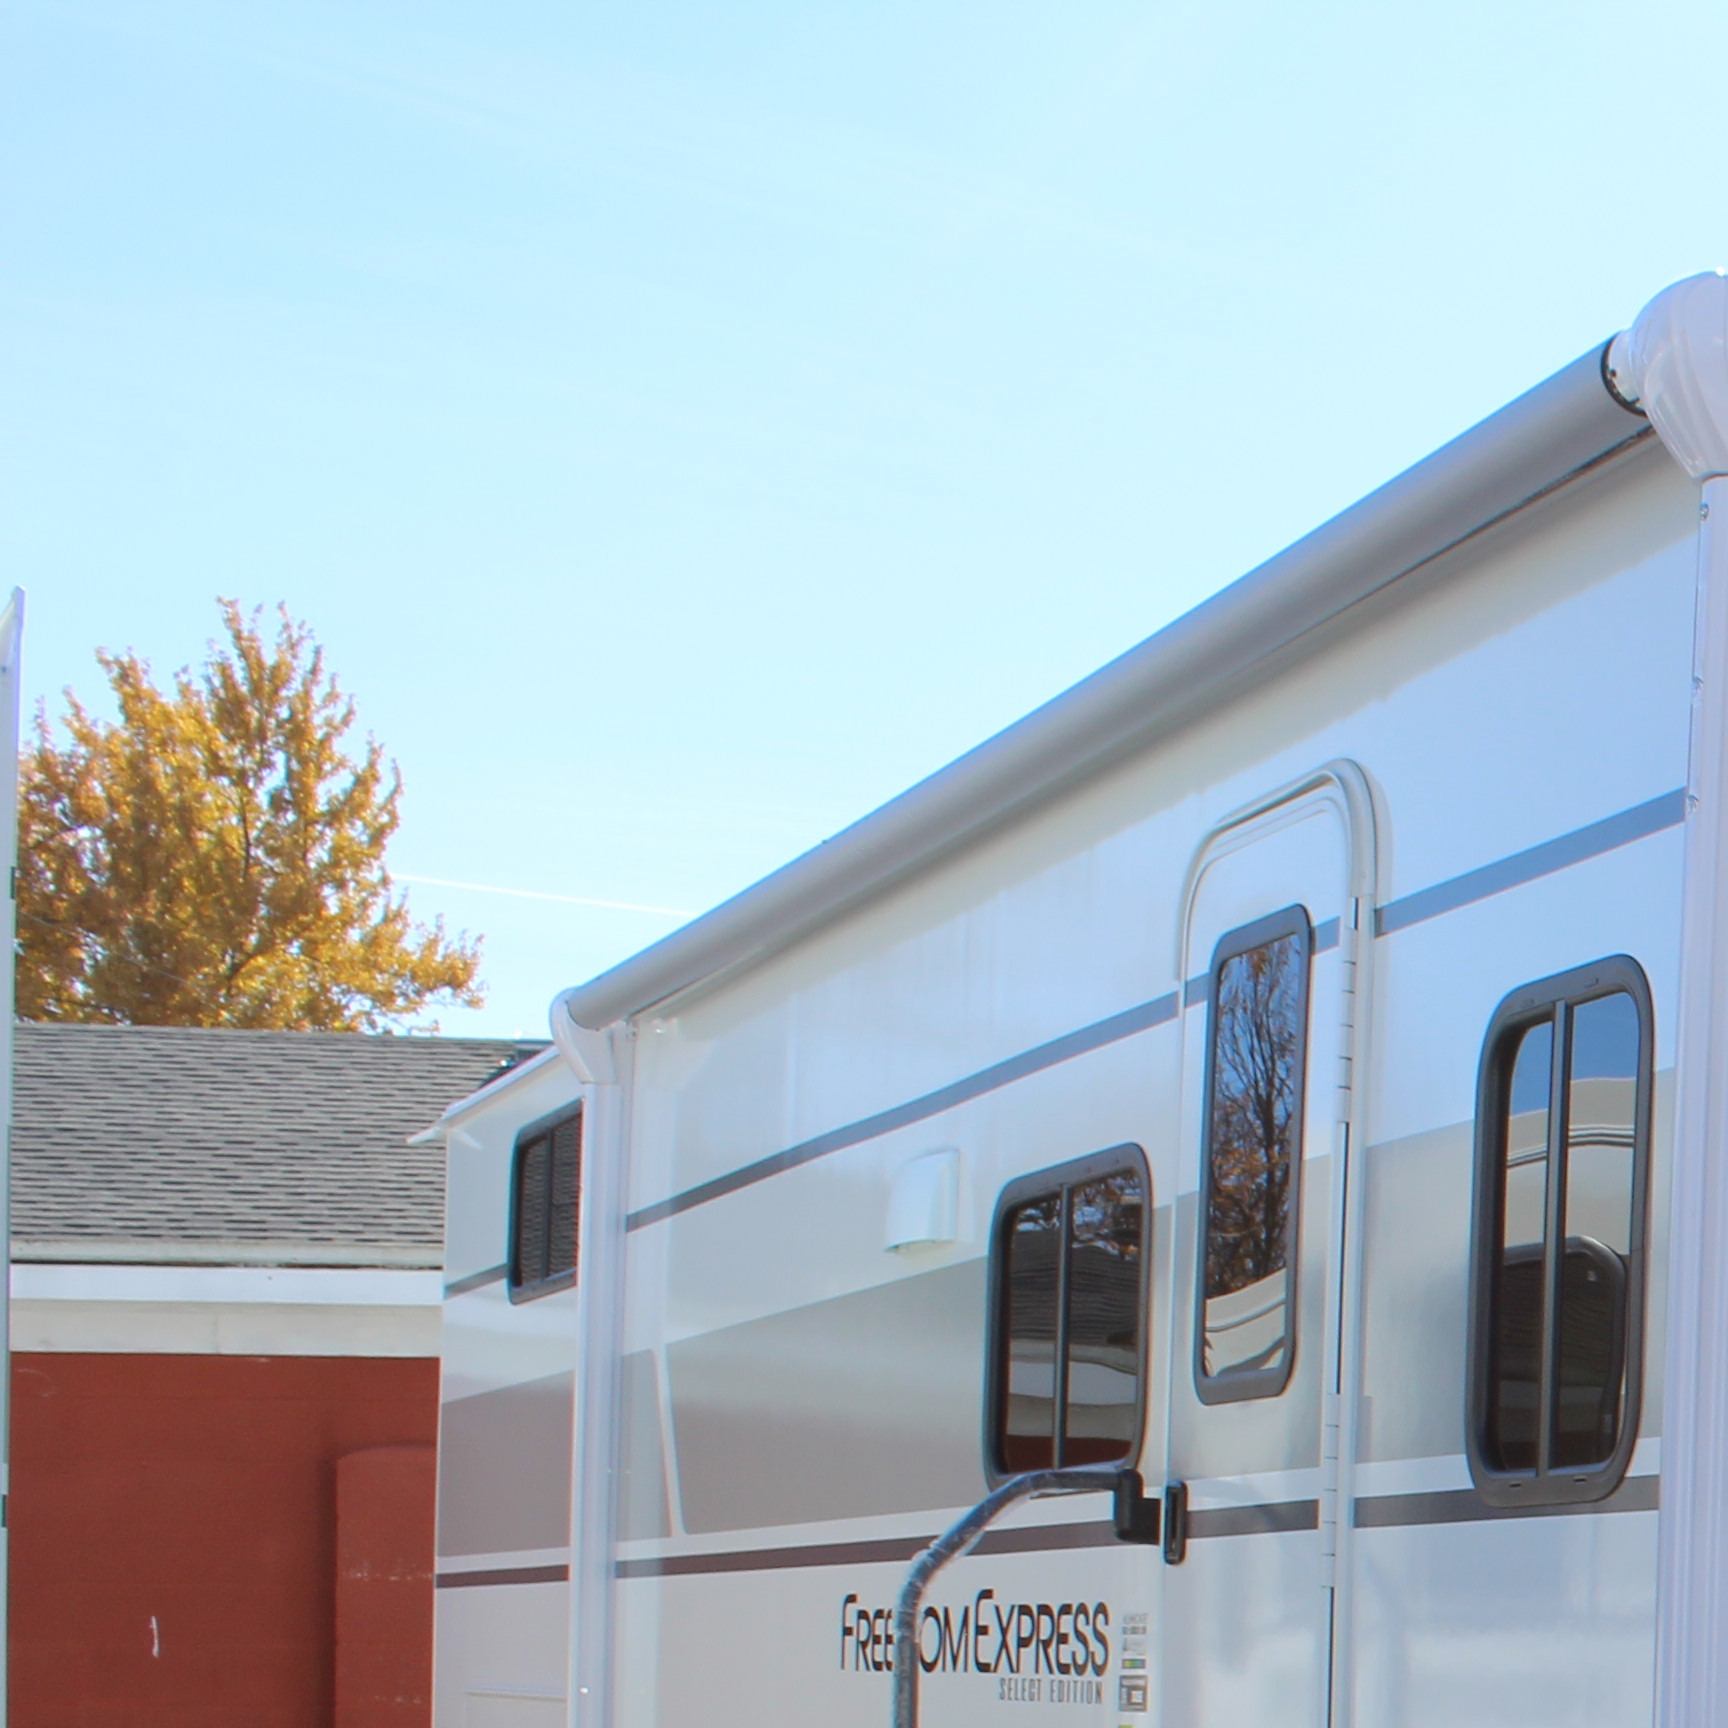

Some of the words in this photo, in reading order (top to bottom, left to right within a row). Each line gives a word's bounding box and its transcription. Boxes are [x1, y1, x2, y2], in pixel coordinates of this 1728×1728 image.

[840, 1593, 970, 1673] FREEOM
[999, 1677, 1042, 1702] SELECT
[1050, 1679, 1103, 1705] EDITION
